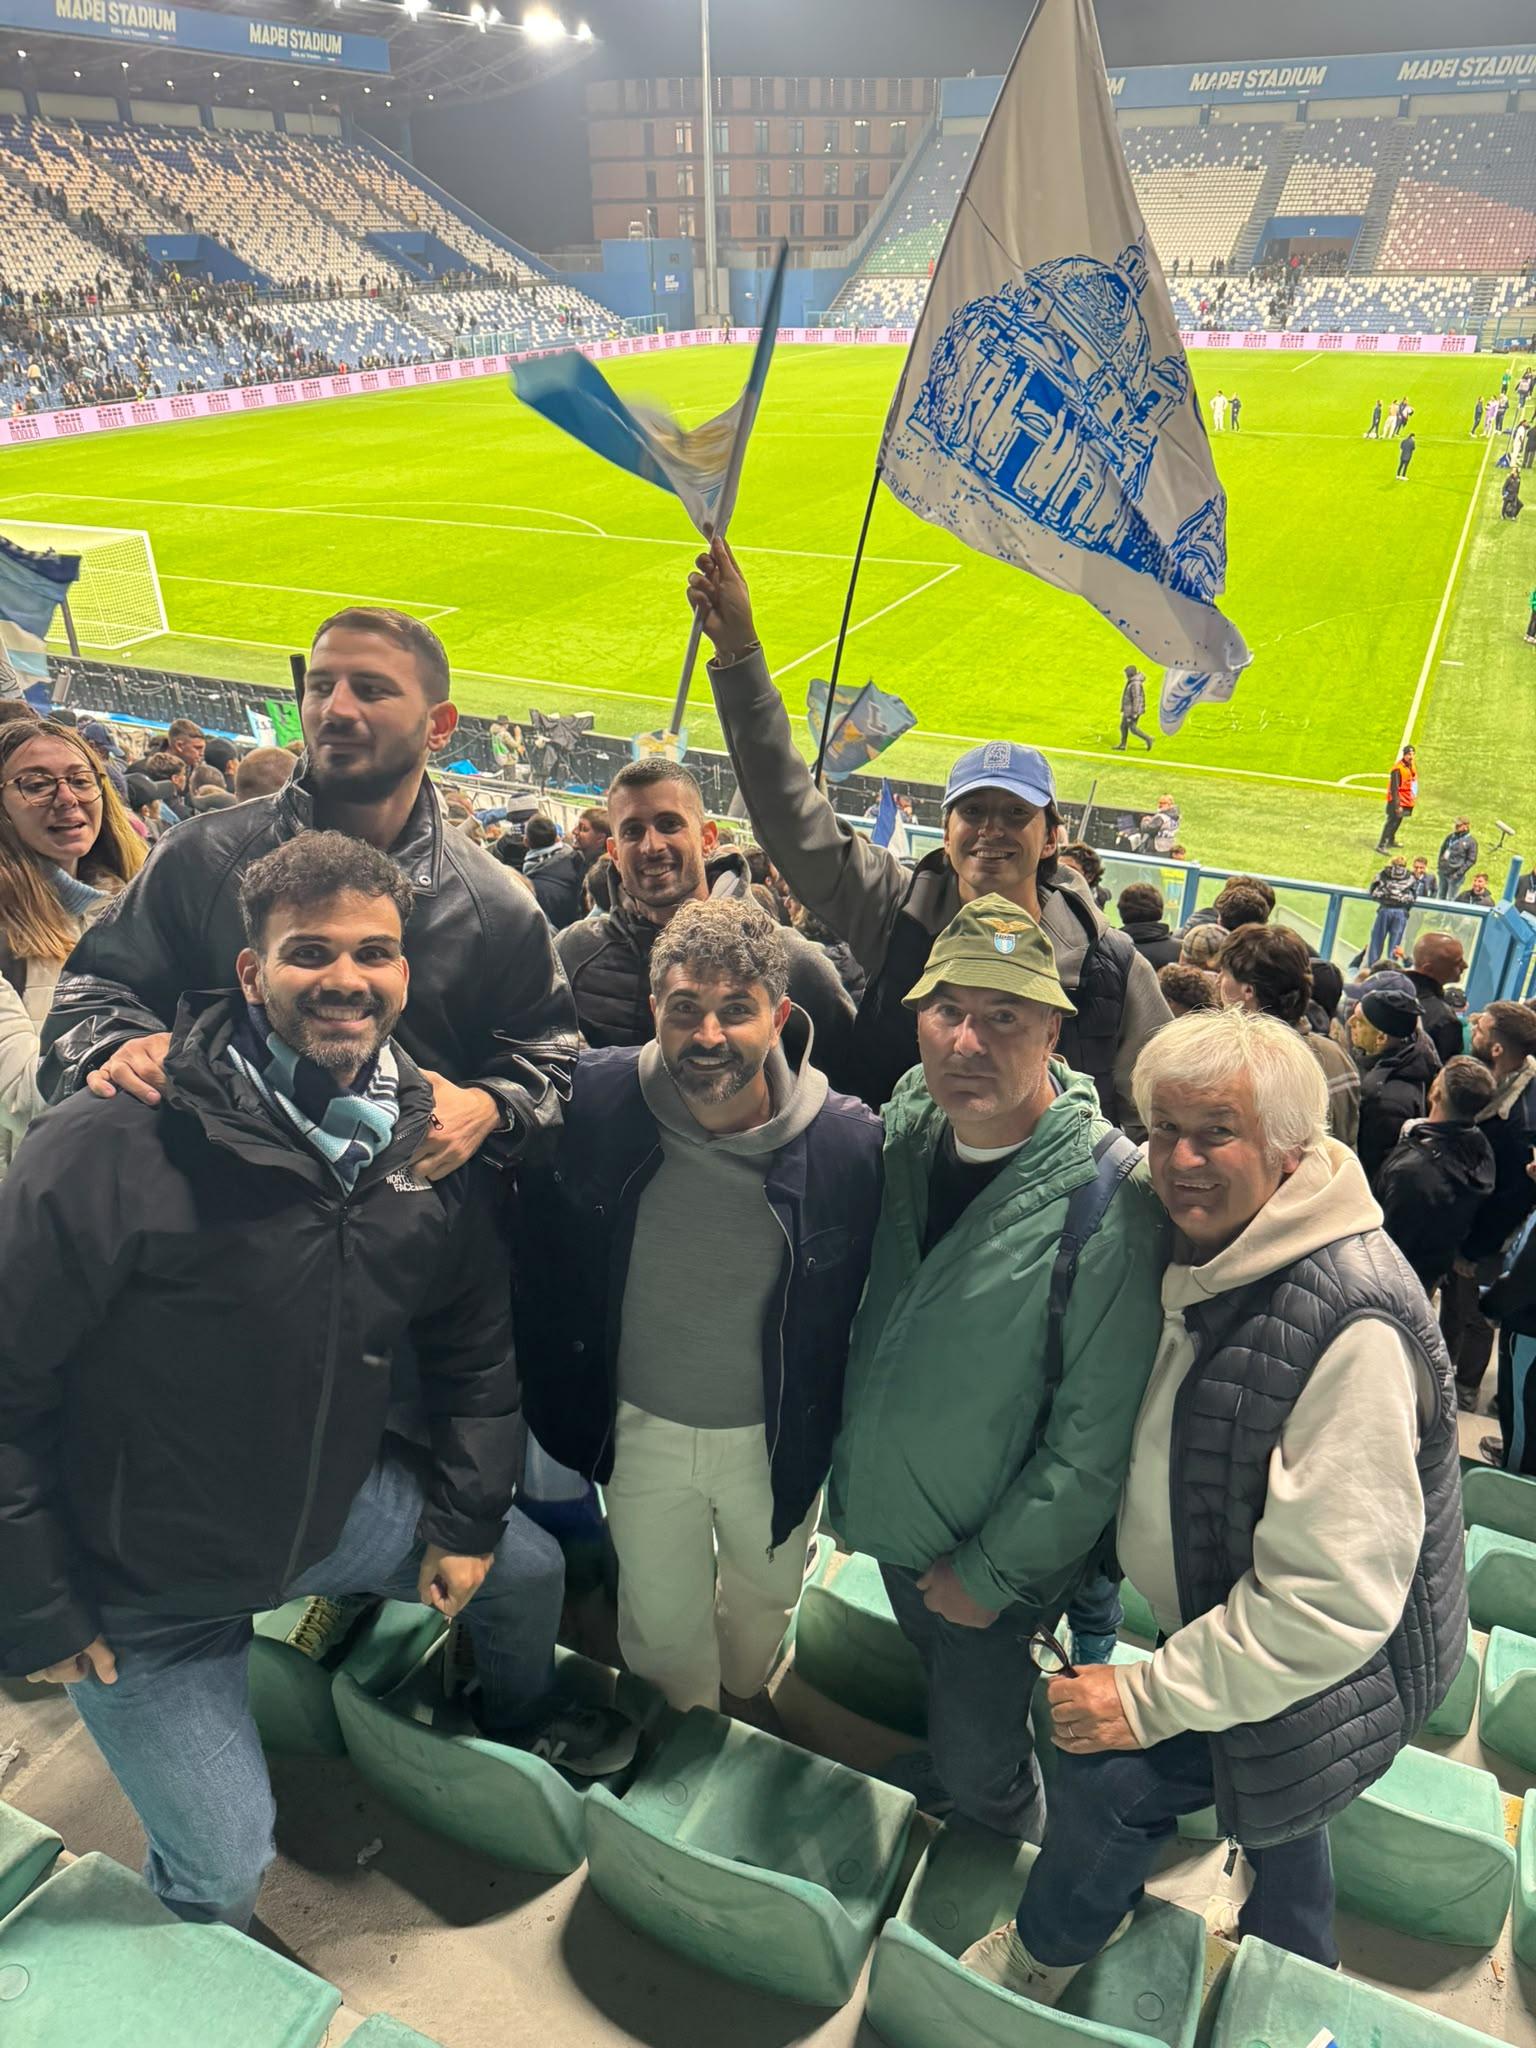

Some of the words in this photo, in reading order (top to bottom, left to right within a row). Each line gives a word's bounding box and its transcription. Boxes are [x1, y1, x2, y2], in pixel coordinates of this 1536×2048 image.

[56, 0, 106, 22] MAPEI
[109, 1, 176, 32] STADIUM
[249, 23, 288, 48] MAPEI
[289, 28, 342, 55] STADIUM
[1189, 71, 1245, 91] MAPEI
[1244, 66, 1328, 89] STADIUM
[1397, 58, 1460, 80] MAPEI
[393, 1182, 416, 1193] FACE
